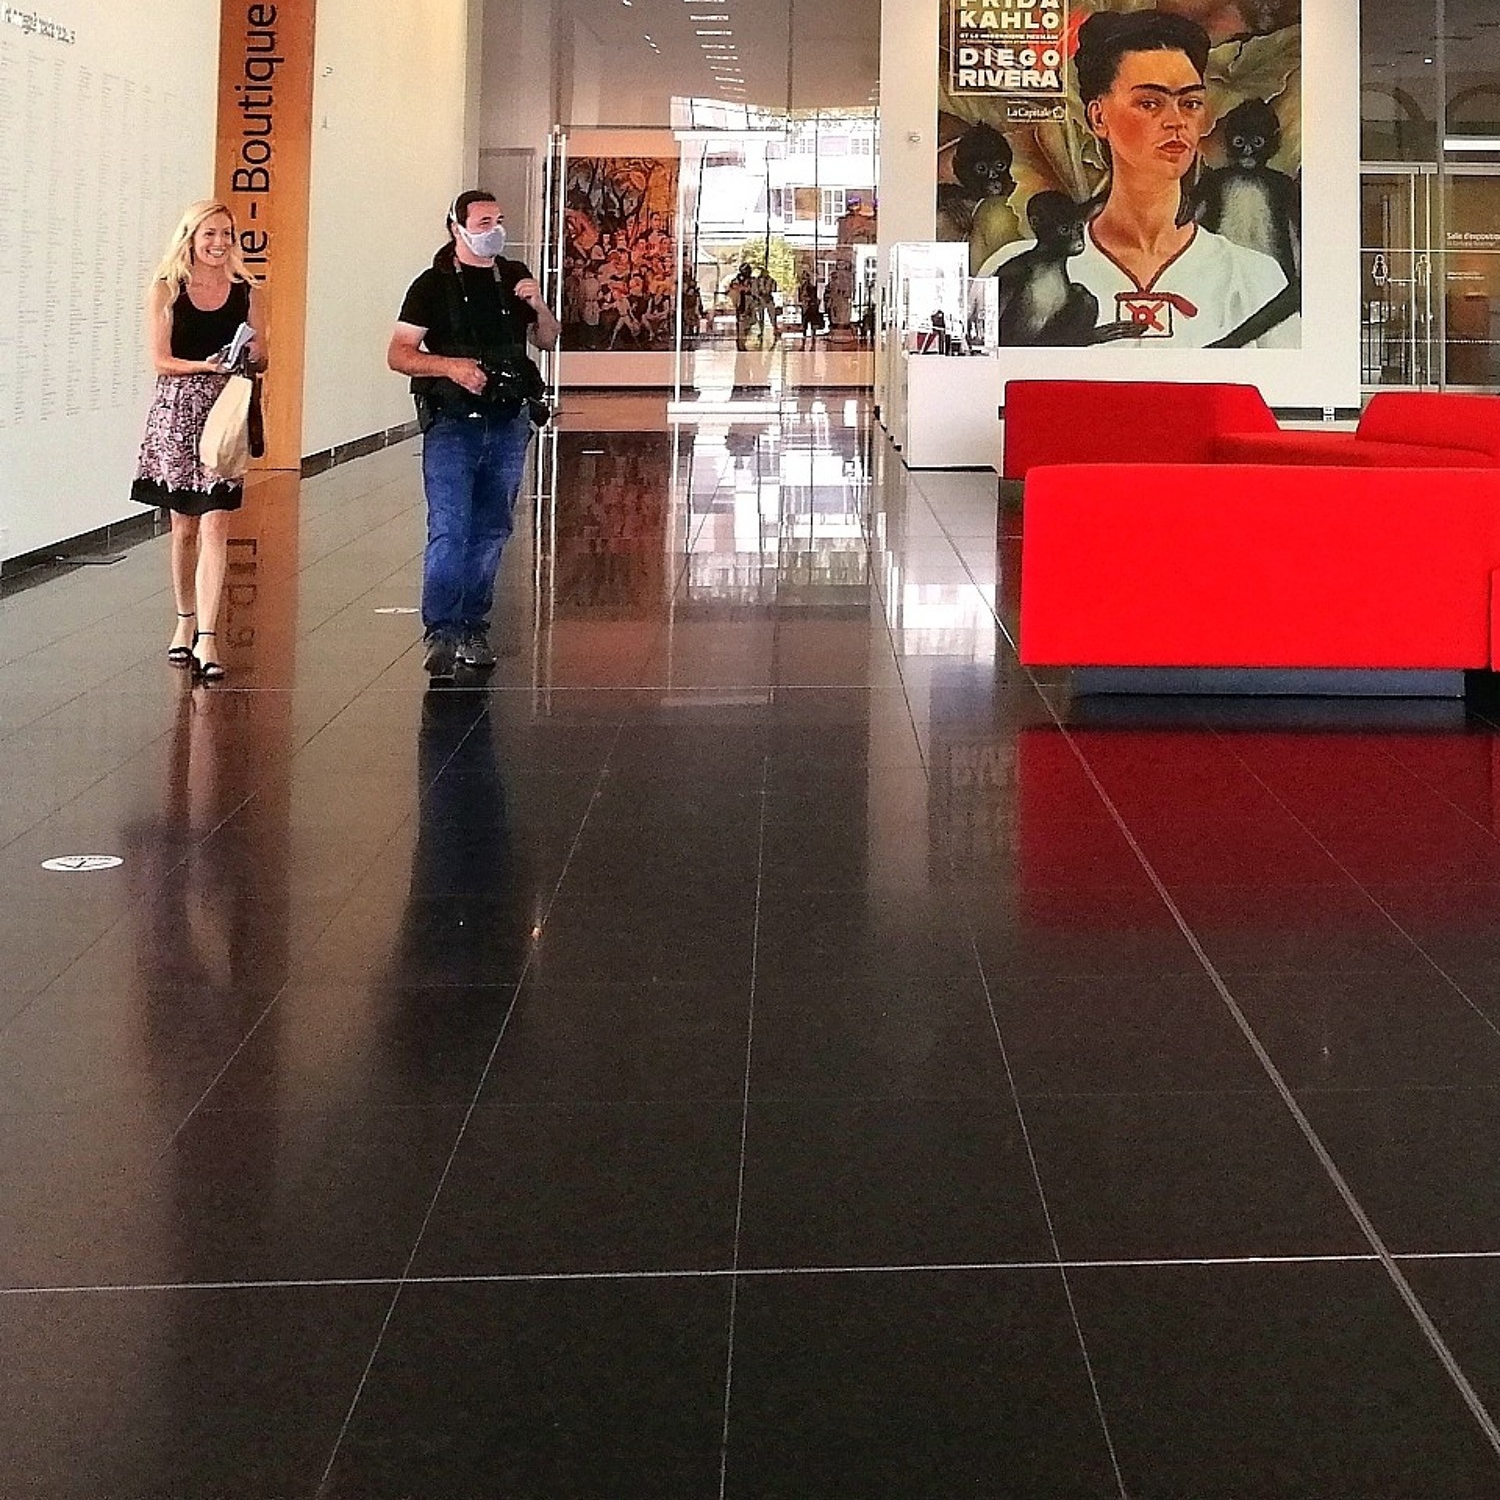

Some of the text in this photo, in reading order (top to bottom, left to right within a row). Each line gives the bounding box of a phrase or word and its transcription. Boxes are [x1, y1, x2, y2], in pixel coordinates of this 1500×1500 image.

[960, 10, 1060, 29] KAHLO
[959, 48, 1060, 67] DIEGO
[959, 69, 1059, 88] RIVERA
[231, 3, 285, 193] Boutique
